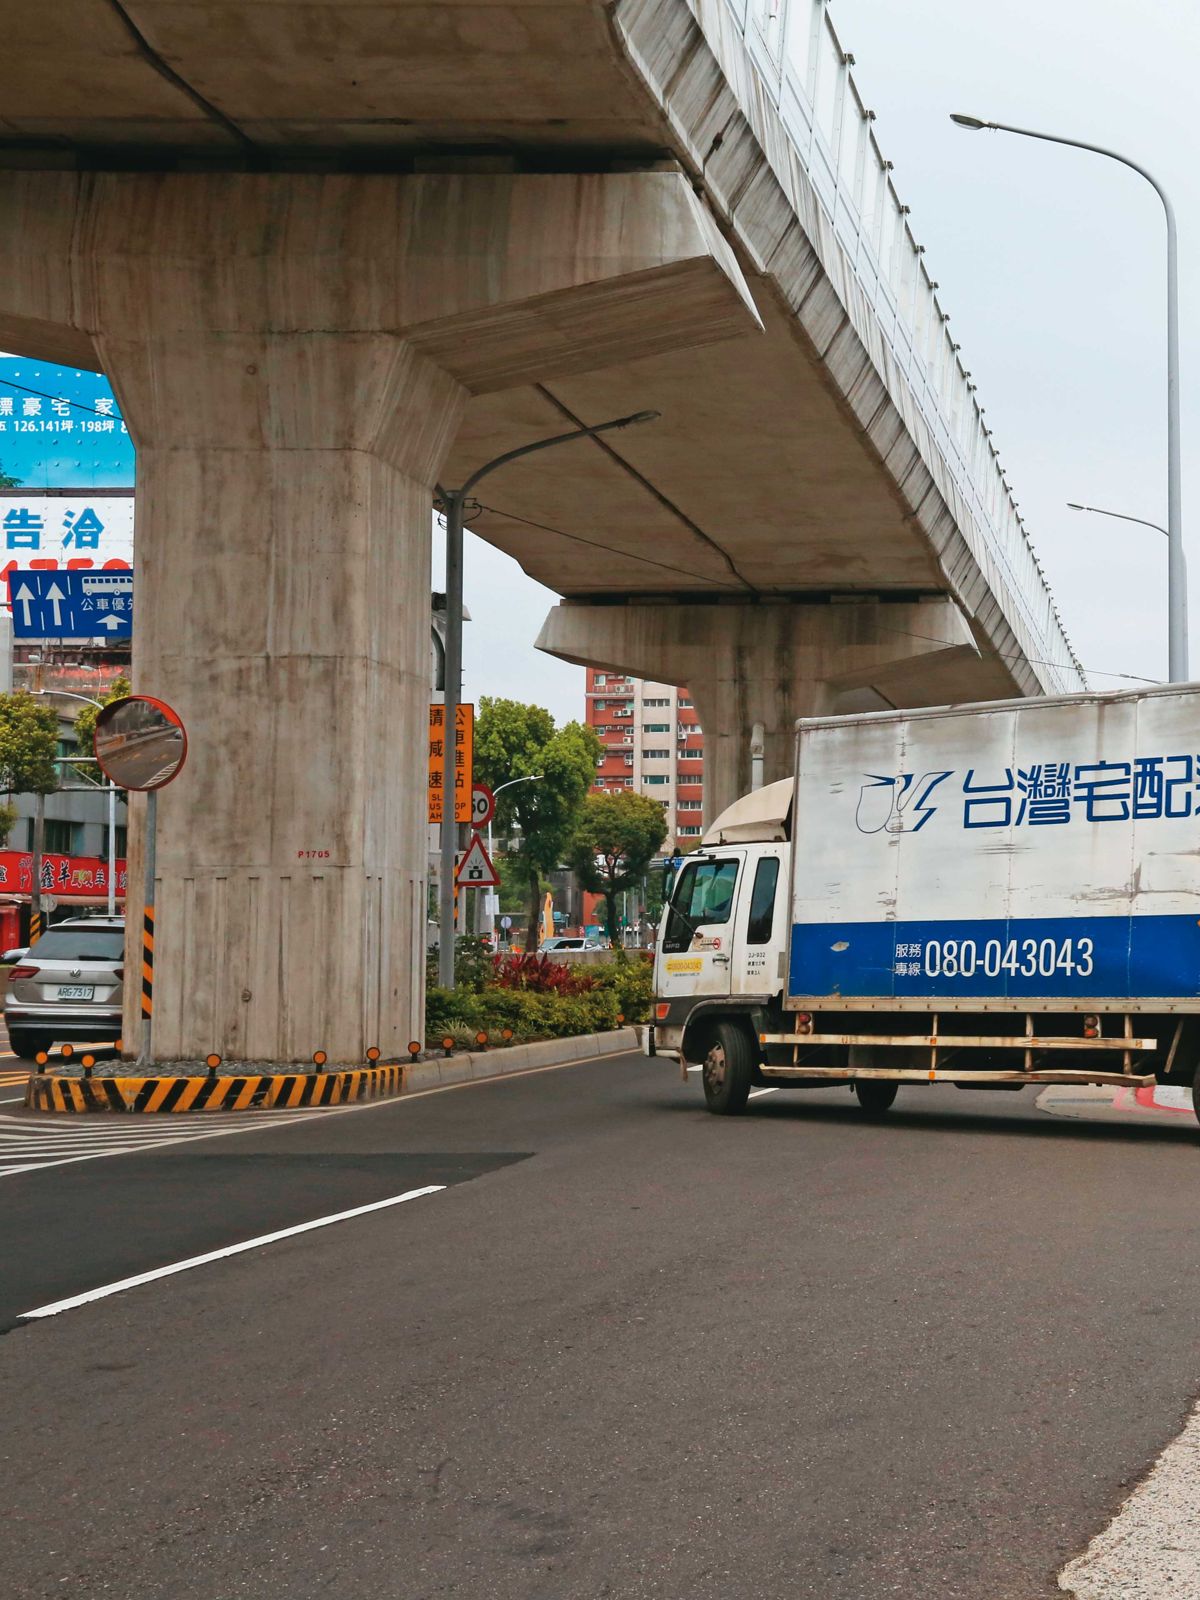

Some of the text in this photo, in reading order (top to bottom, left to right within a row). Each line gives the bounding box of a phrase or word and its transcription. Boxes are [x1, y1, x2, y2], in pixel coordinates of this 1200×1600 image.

[895, 944, 921, 957] 服務
[925, 938, 1094, 977] 080-043043
[895, 962, 921, 975] 專線
